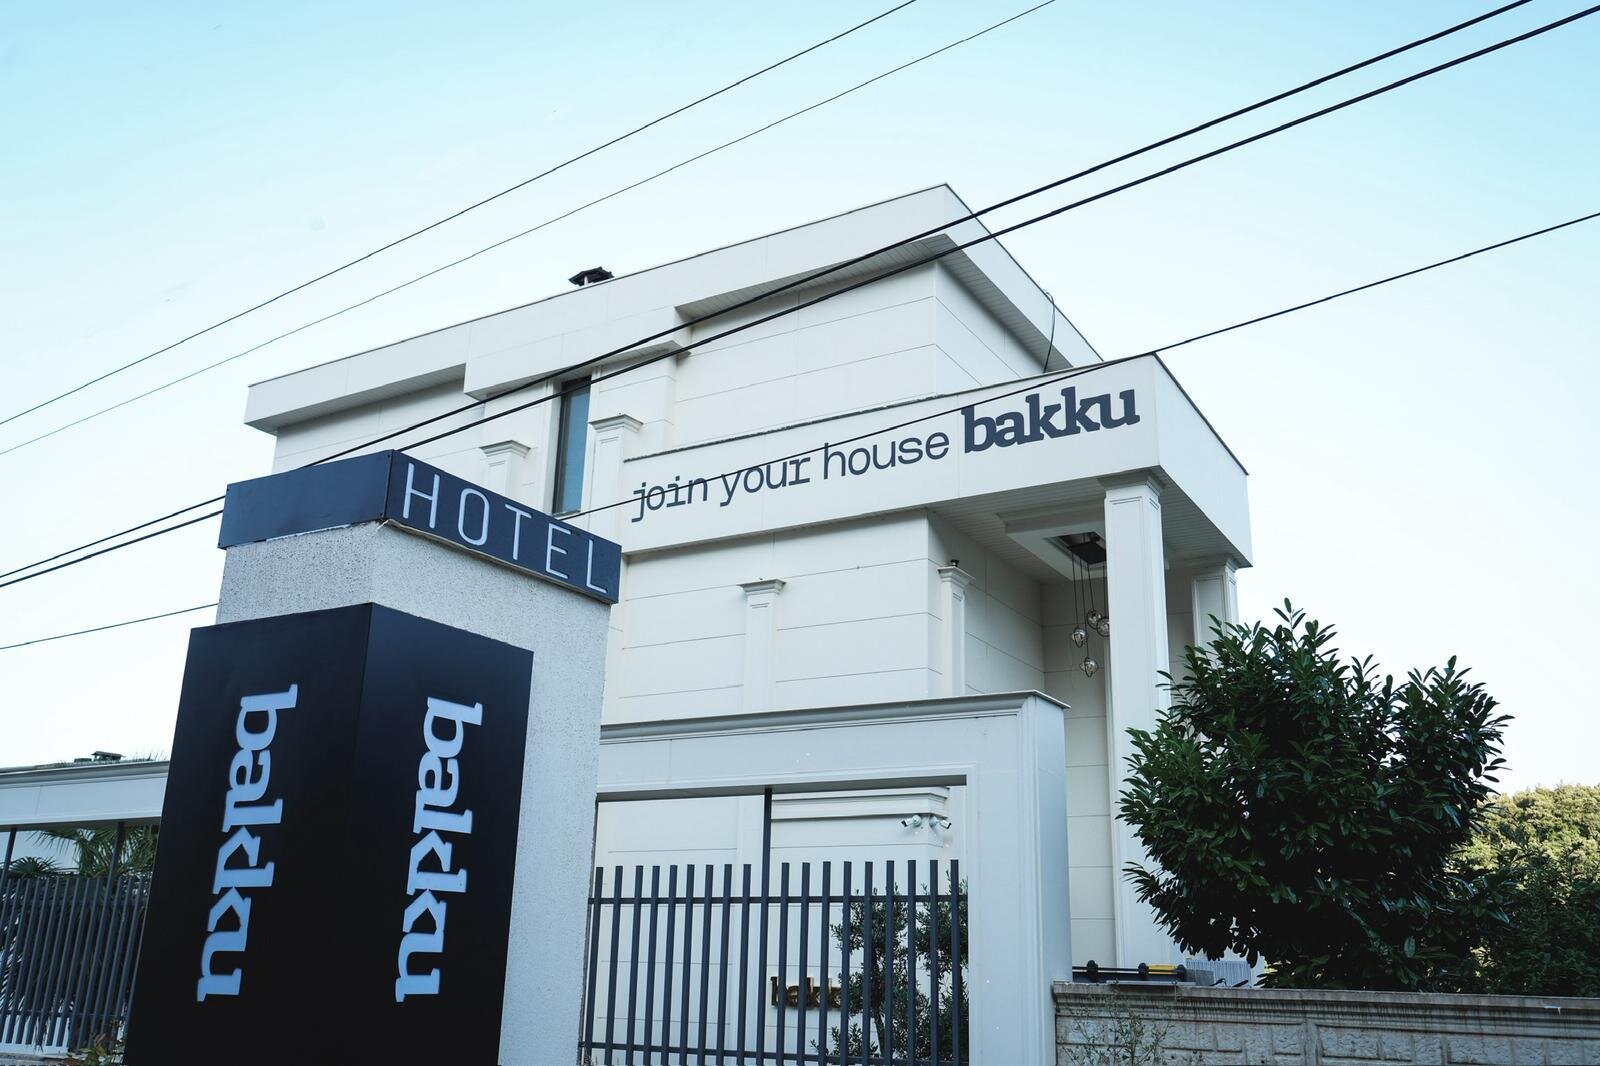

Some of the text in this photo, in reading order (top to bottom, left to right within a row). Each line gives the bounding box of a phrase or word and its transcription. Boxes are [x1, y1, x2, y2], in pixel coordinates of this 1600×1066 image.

[402, 462, 608, 594] HOTEL
[631, 386, 1140, 523] join your house bakku
[197, 683, 299, 1003] bakku
[395, 696, 483, 1003] bakku
